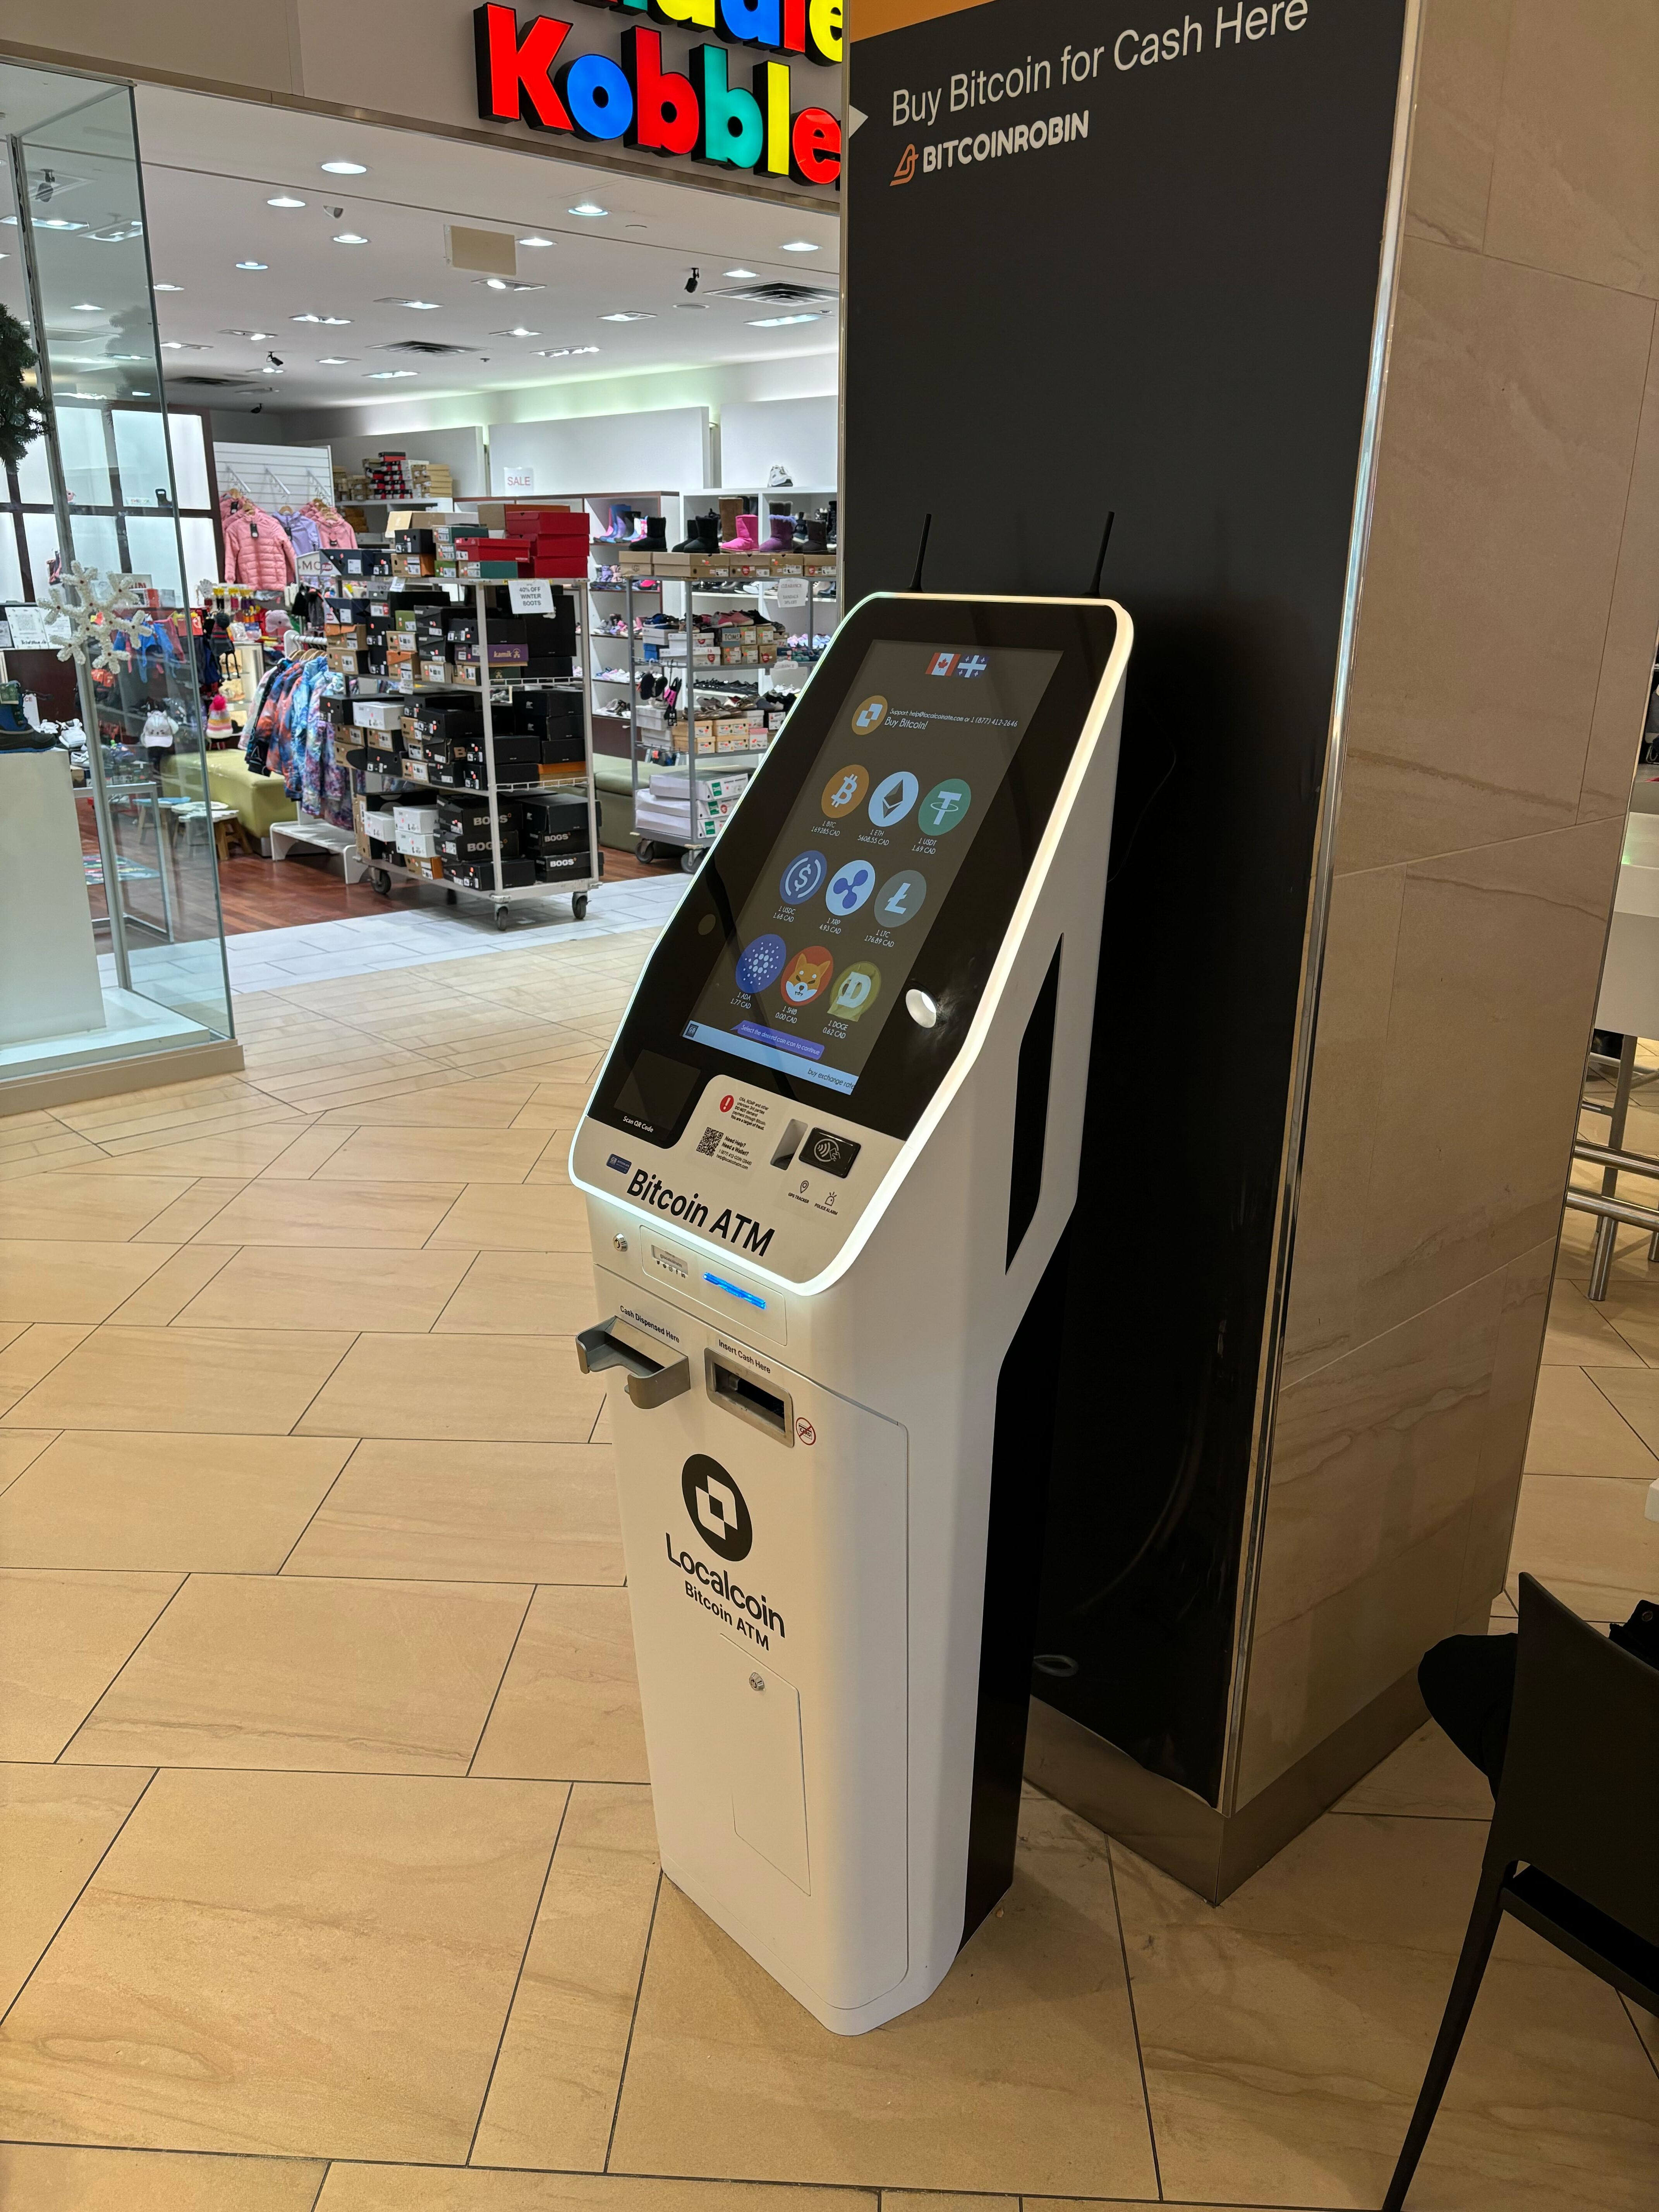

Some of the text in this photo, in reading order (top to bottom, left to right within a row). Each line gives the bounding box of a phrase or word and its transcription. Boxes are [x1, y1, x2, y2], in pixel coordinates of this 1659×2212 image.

[893, 0, 1308, 126] Buy Bitcoin for Cash Here
[923, 110, 1089, 173] BITCOINROBIN
[507, 476, 531, 486] SALE
[884, 716, 928, 730] Buy Bitcoin!
[975, 716, 991, 725] (877)
[991, 718, 1018, 727] 412-2646
[473, 814, 508, 826] BOS
[811, 826, 829, 835] 169285
[544, 833, 569, 843] BOGS
[857, 835, 878, 844] 5608.55
[923, 838, 938, 847] USDT
[550, 859, 574, 867] BOGS
[782, 907, 796, 915] USDC
[864, 935, 882, 944] 176.89
[787, 1006, 798, 1015] SHIB
[832, 1021, 849, 1031] DOGE
[823, 1027, 846, 1039] 0.62 CAD
[742, 1024, 754, 1033] Select
[762, 1031, 777, 1041] desired
[801, 1044, 820, 1055] continue
[807, 1068, 818, 1077] buy
[818, 1074, 843, 1085] exchange
[623, 1116, 634, 1125] Scan
[641, 1123, 654, 1133] Code
[735, 1140, 746, 1148] Help?
[735, 1147, 749, 1156] Wallet?
[795, 1195, 810, 1204] TRACKER
[627, 1168, 775, 1257] Bitcoin ATM
[620, 1305, 680, 1343] Cash Dispensed Here
[719, 1339, 771, 1374] Insert Cash Here
[666, 1532, 785, 1638] Localcoin
[685, 1580, 769, 1651] Bitcoin ATM
